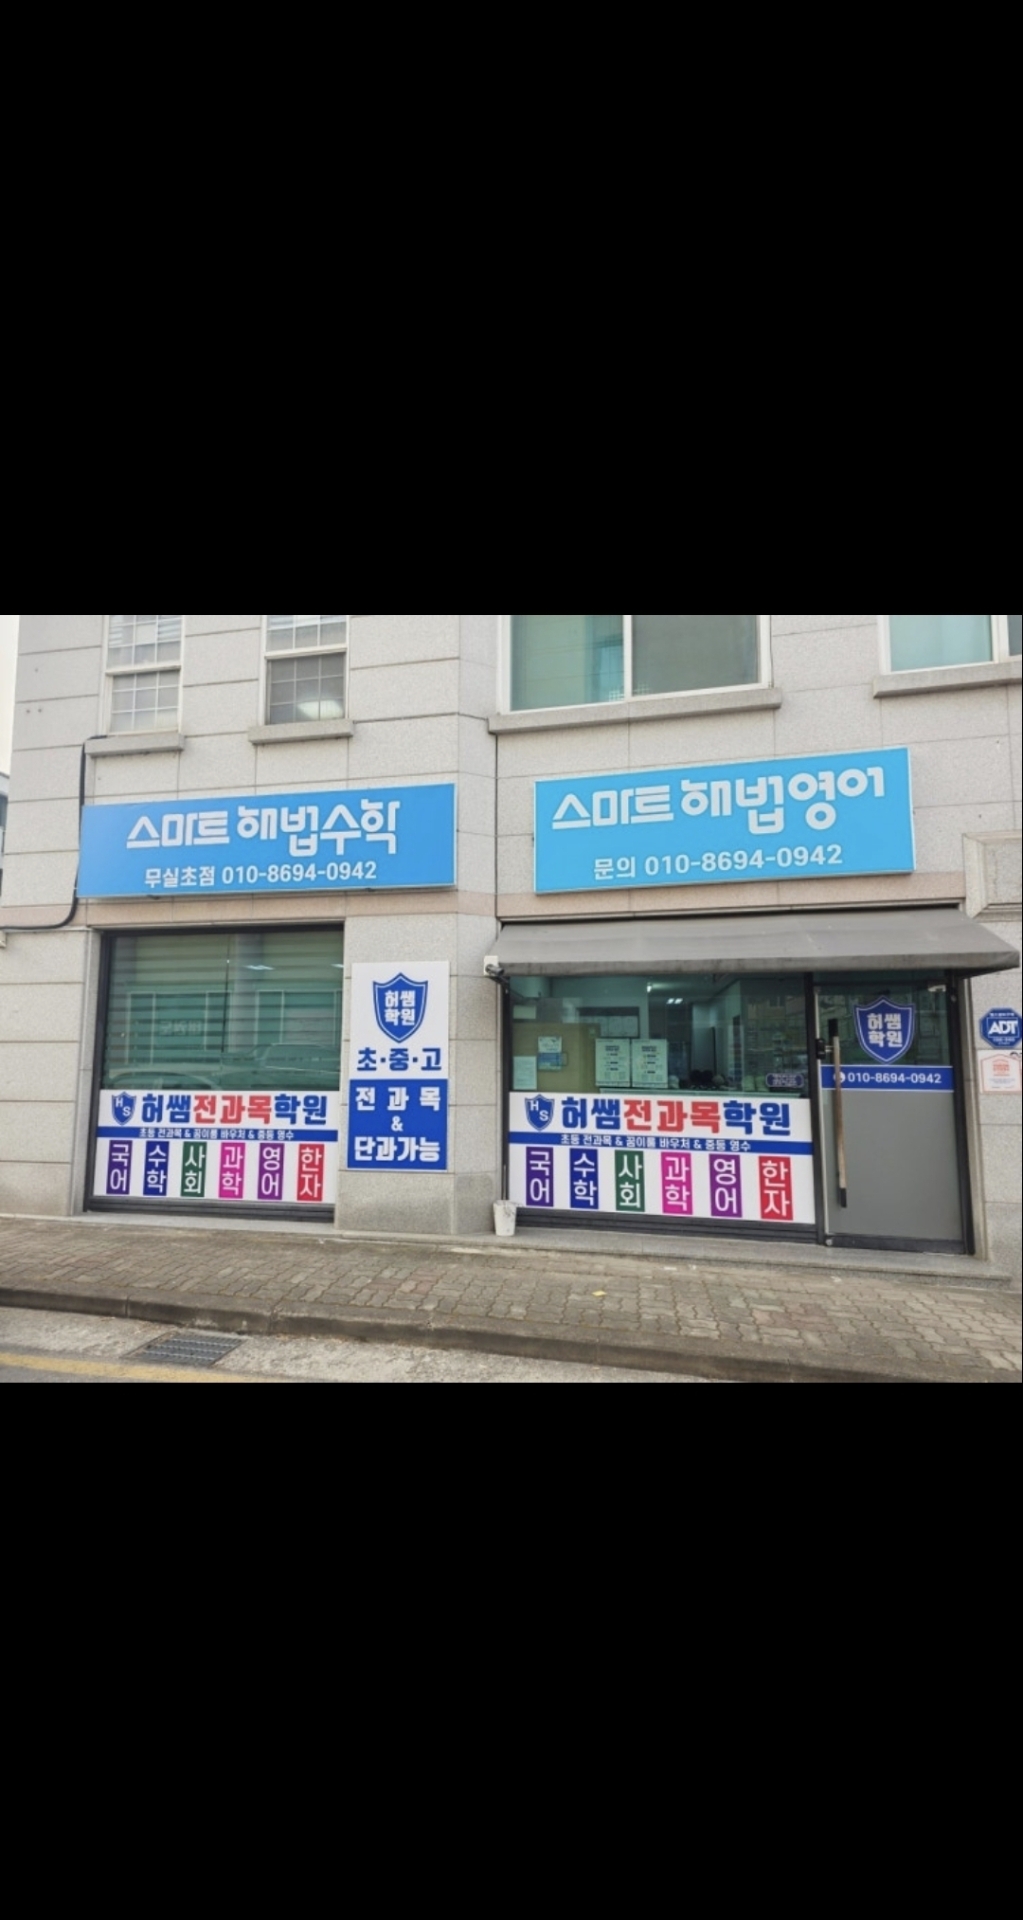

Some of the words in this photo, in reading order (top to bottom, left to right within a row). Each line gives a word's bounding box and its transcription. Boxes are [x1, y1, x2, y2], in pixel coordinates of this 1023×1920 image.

[552, 784, 674, 830] 스마트
[681, 766, 885, 835] 해법영어
[126, 810, 230, 849] 스마트
[237, 798, 400, 857] 해법수학
[144, 866, 215, 888] 무실초점
[222, 861, 377, 884] 010-8694-0942
[594, 856, 636, 880] 문의
[644, 844, 843, 876] 010-8694-0942
[384, 990, 415, 1007] 허쌤
[384, 1009, 415, 1026] 학원
[867, 1013, 902, 1030] 허쌤
[868, 1030, 902, 1048] 학원
[988, 1020, 1018, 1035] ADT
[847, 1072, 942, 1084] 010-8694-0942
[391, 1115, 403, 1131] &
[615, 1136, 623, 1146] &
[660, 1137, 690, 1149] 바우처
[693, 1139, 702, 1149] &
[110, 1144, 130, 1191] 국어
[147, 1144, 167, 1193] 수학
[184, 1145, 206, 1194] 사회
[221, 1146, 243, 1196] 과학
[260, 1147, 281, 1196] 영어
[300, 1148, 323, 1198] 한자
[354, 1136, 440, 1162] 단과가능
[529, 1151, 551, 1203] 국어
[573, 1153, 597, 1206] 수학
[618, 1155, 642, 1208] 사회
[665, 1156, 690, 1212] 과학
[713, 1158, 738, 1214] 영어
[762, 1160, 790, 1216] 한자
